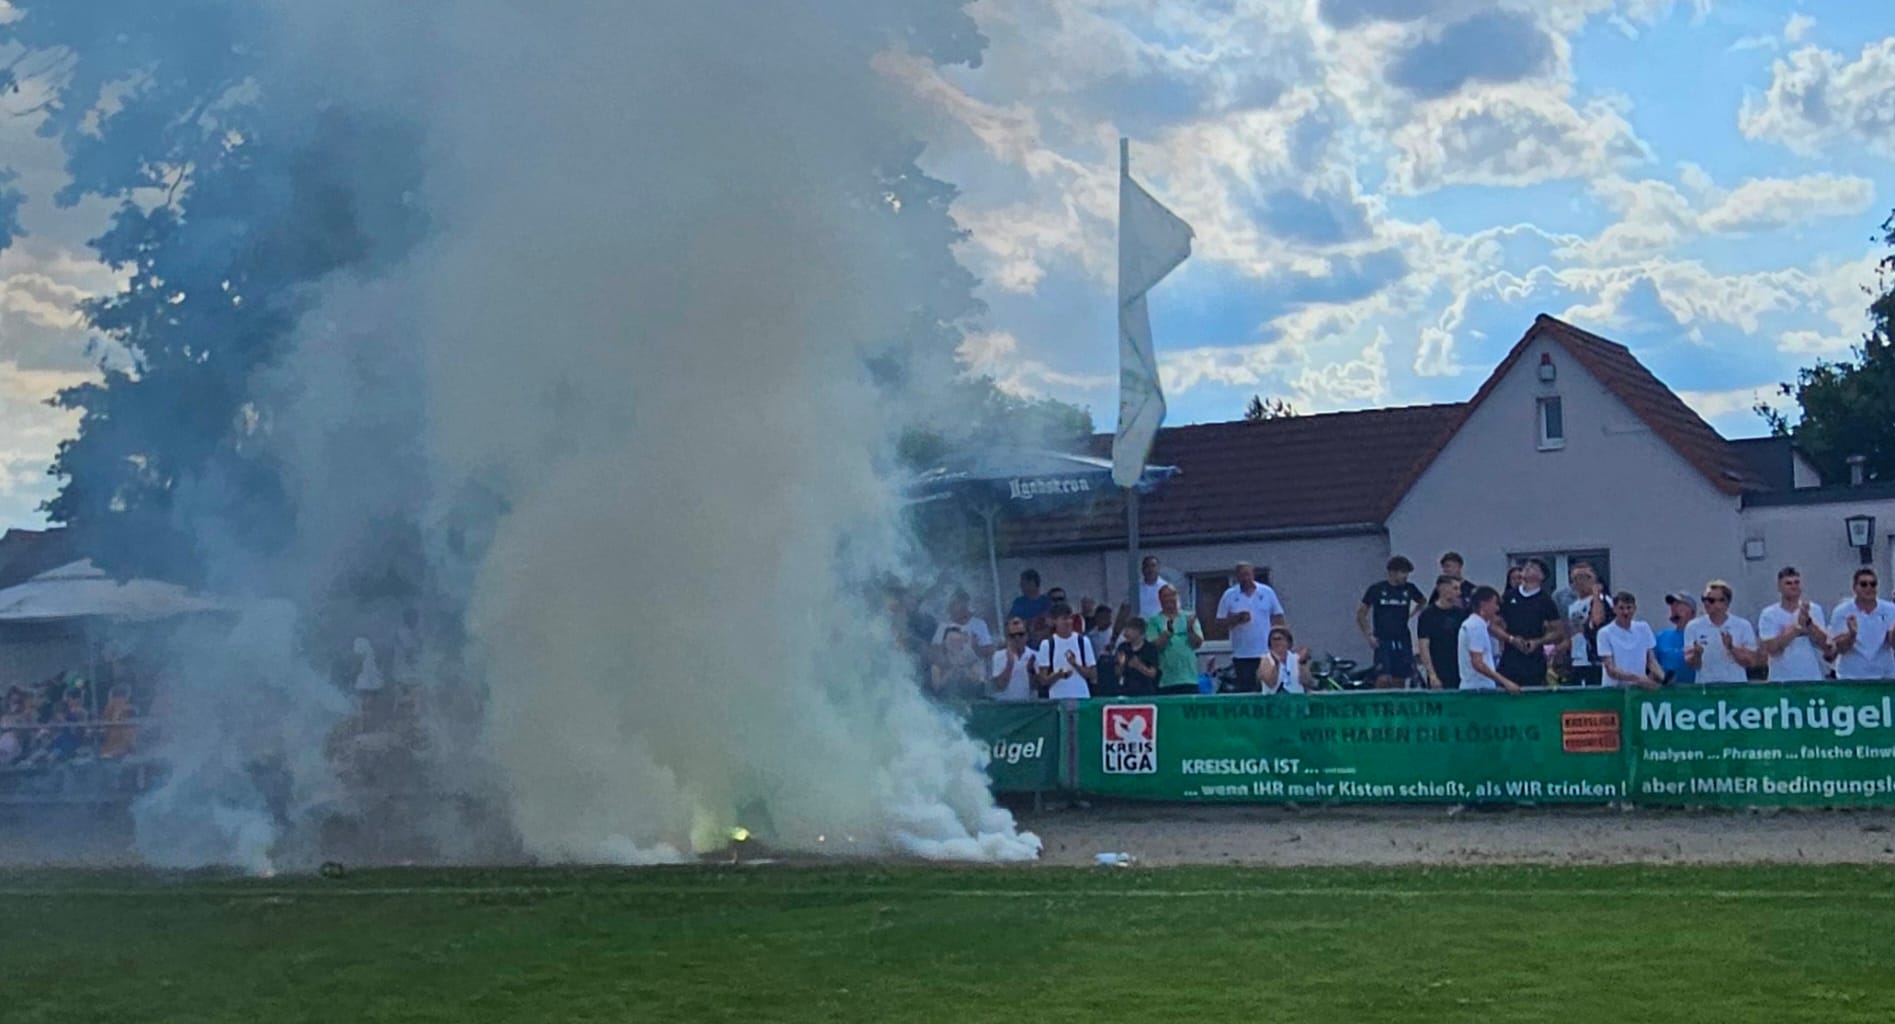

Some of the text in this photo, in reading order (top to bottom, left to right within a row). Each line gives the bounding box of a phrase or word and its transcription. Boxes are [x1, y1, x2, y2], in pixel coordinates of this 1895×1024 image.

[1641, 696, 1892, 736] Meckerhügel
[1300, 727, 1338, 744] WIR
[1342, 726, 1410, 744] HABEN
[1454, 721, 1541, 743] LÖSUNG
[1105, 742, 1153, 753] KREIS
[1643, 747, 1704, 763] Analysen
[1723, 747, 1782, 760] Phrasen
[1801, 744, 1853, 759] falsche
[1105, 754, 1153, 771] LIGA
[1182, 758, 1270, 775] KREISLIGA
[1274, 757, 1301, 774] IST
[1201, 783, 1249, 796] wenn
[1253, 781, 1284, 796] IHR
[1288, 781, 1335, 796] mehr
[1339, 780, 1394, 796] Kisten
[1399, 780, 1471, 798] schießt,
[1476, 780, 1502, 796] als
[1505, 780, 1543, 796] WIR
[1547, 779, 1616, 796] trinken
[1642, 777, 1686, 794] aber
[1691, 777, 1758, 794] IMMER
